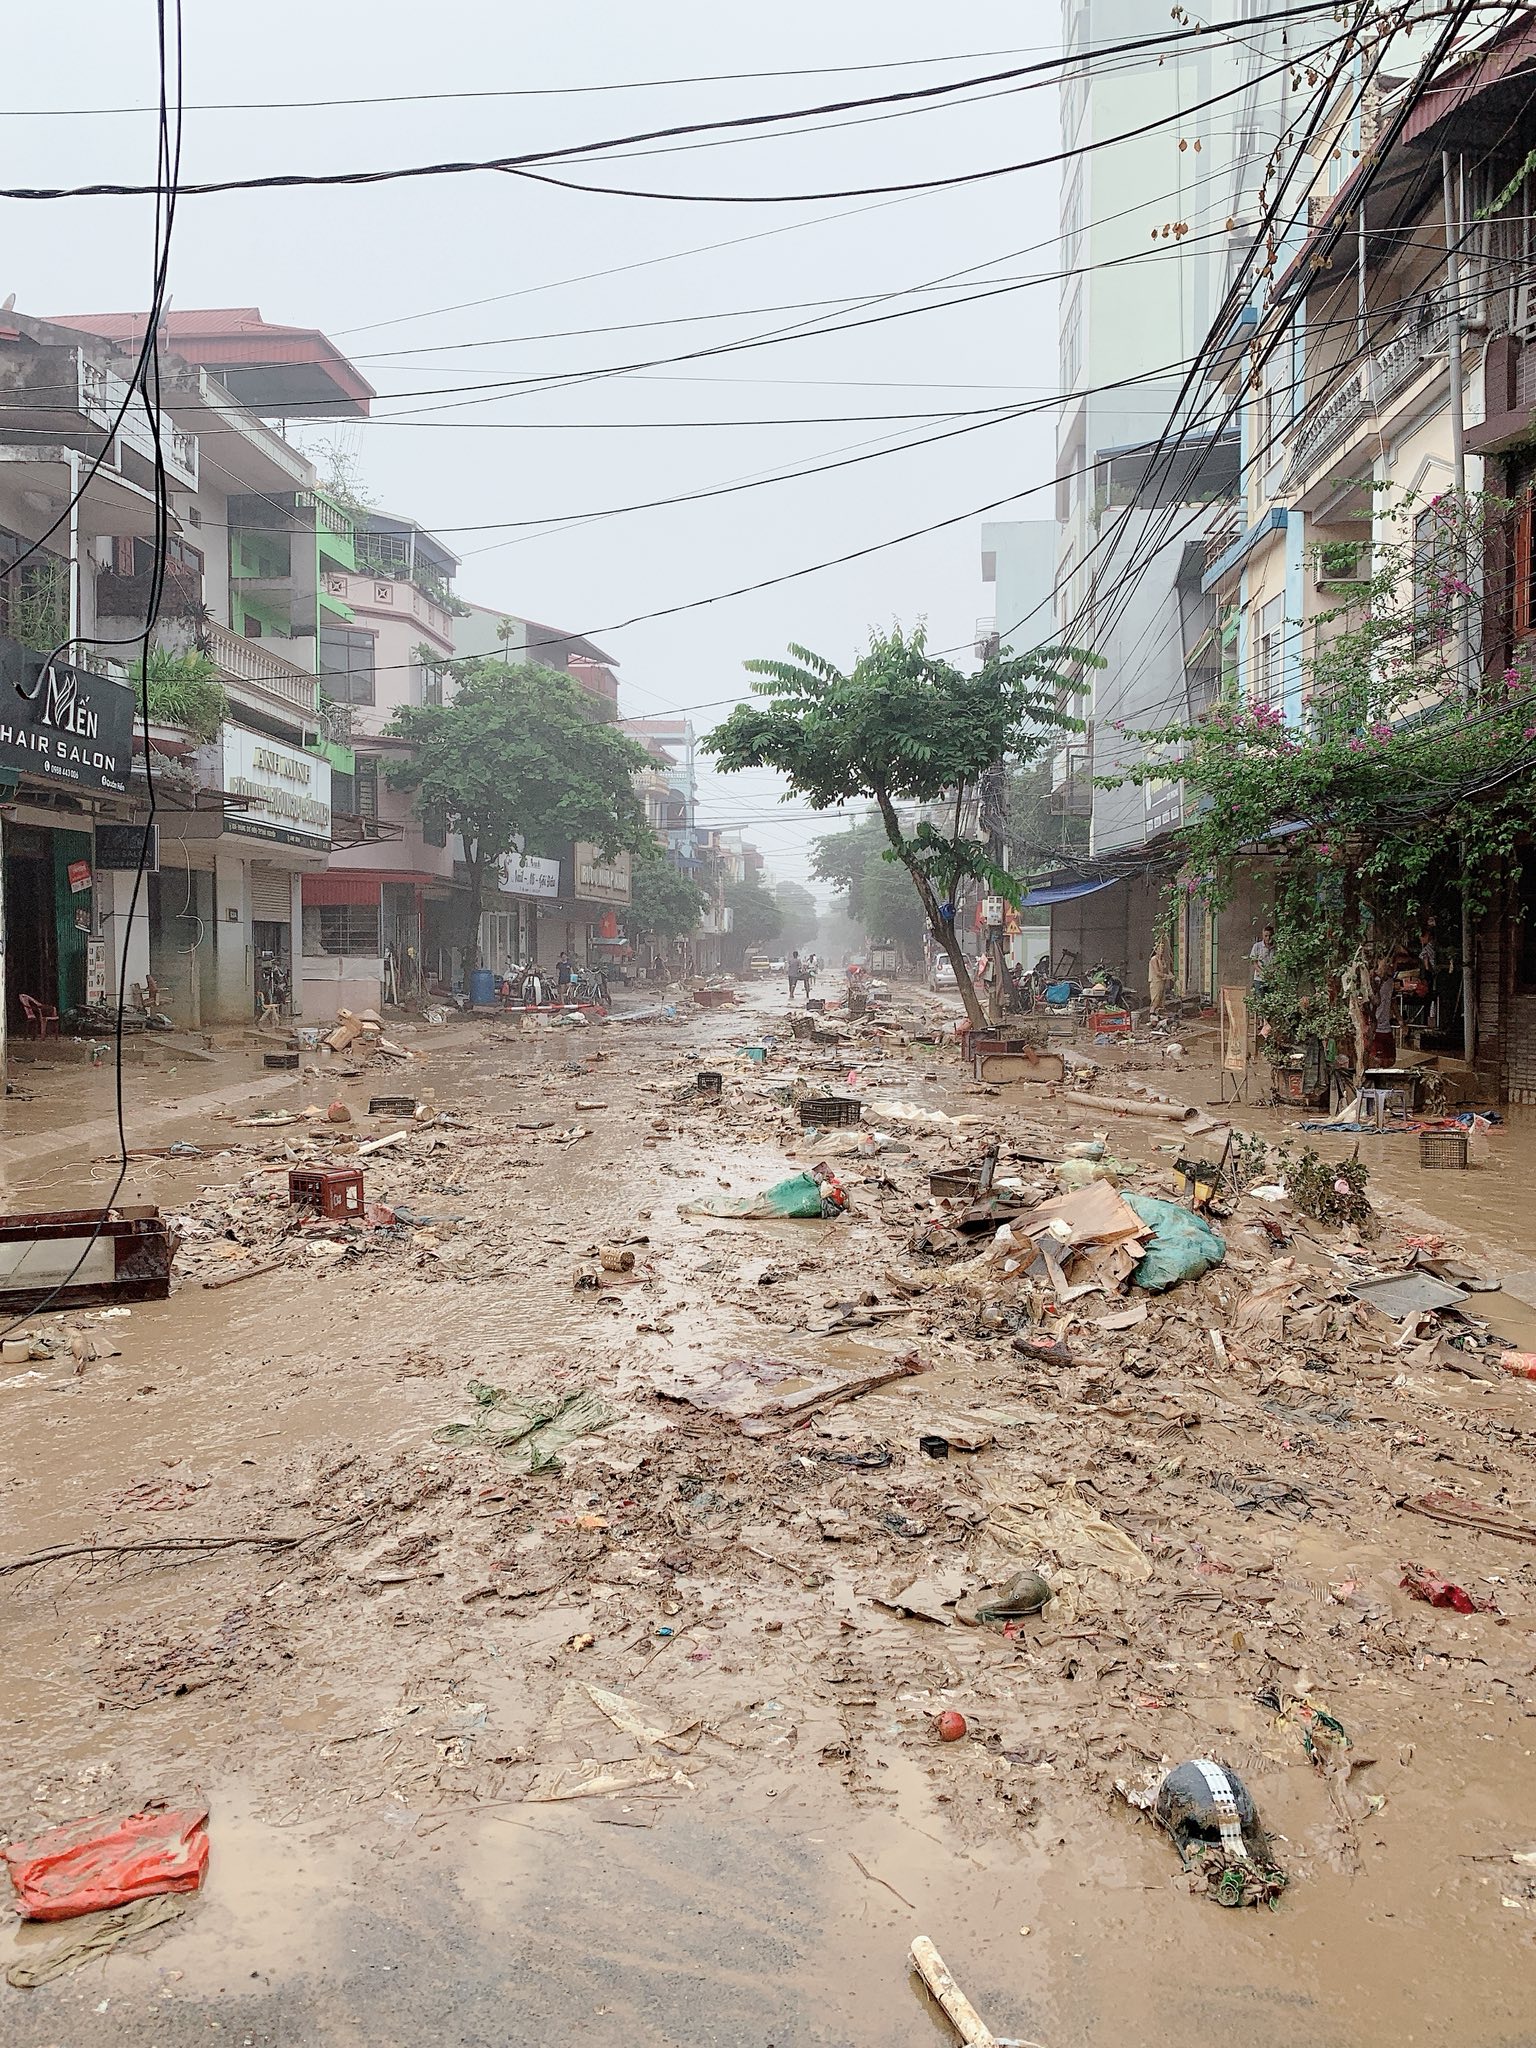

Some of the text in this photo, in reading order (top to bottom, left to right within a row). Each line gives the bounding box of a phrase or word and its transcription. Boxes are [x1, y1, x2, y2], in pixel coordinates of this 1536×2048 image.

[0, 724, 116, 772] HAIR SALON
[62, 767, 71, 777] 443
